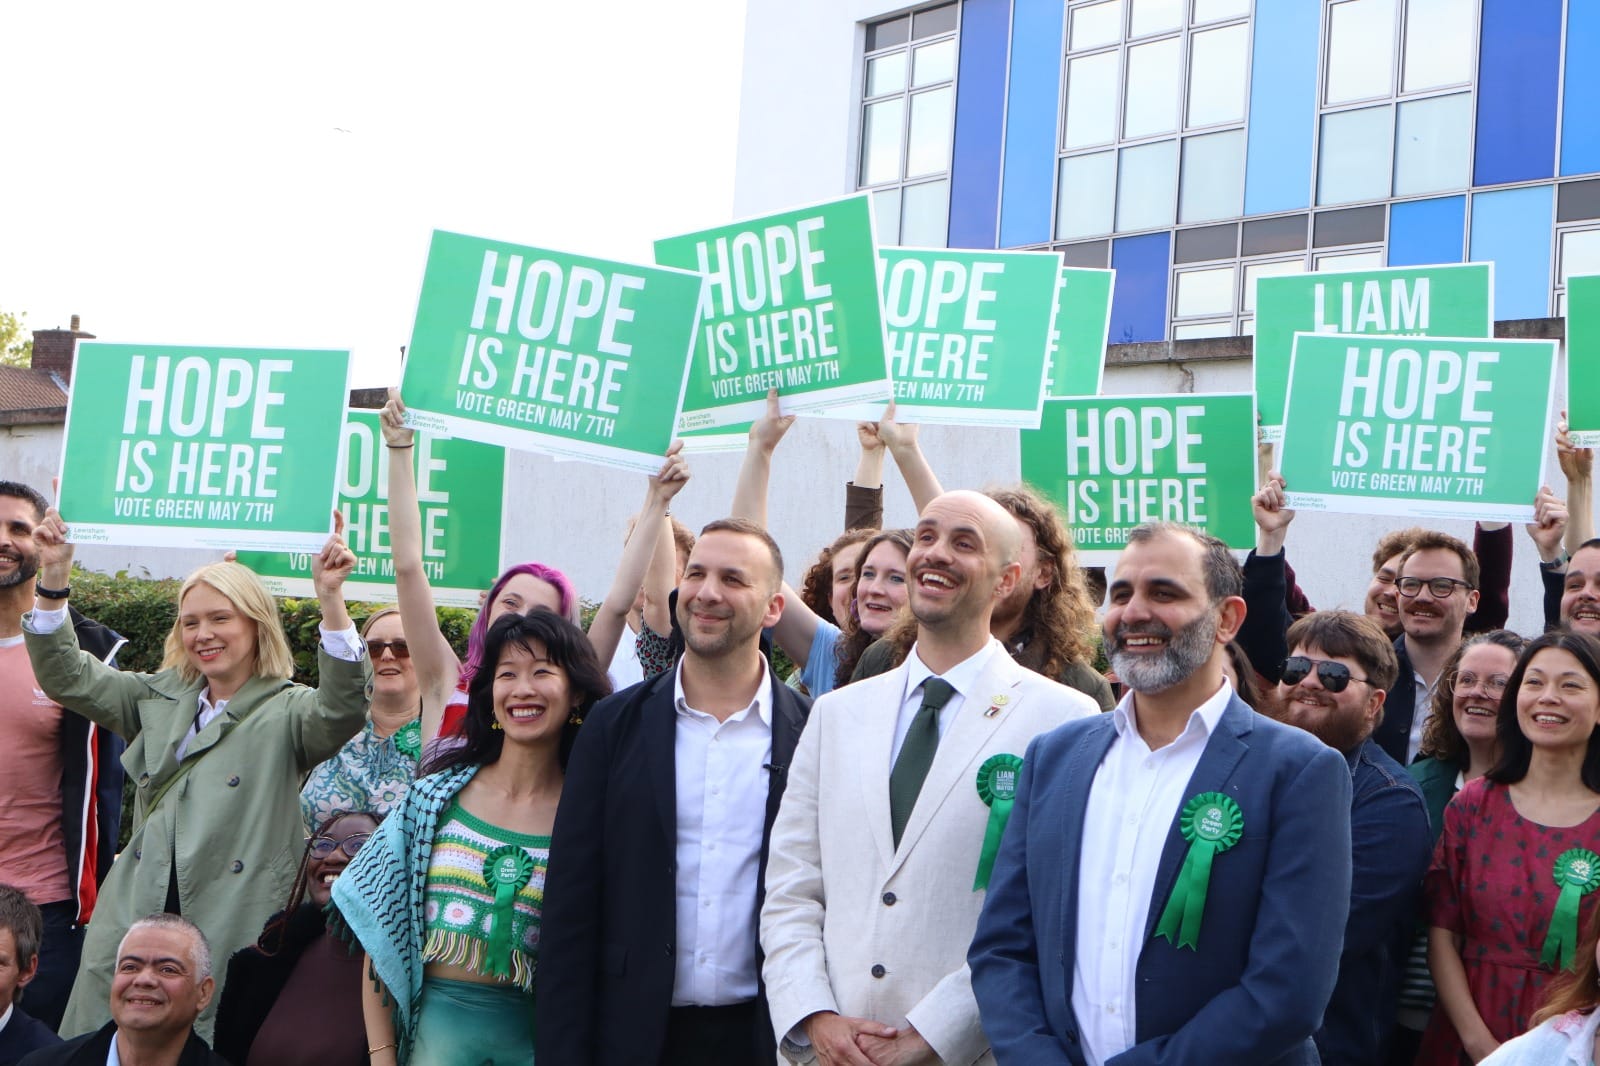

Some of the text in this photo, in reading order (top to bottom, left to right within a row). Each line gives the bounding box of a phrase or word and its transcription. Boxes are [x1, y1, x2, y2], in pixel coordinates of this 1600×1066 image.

[696, 216, 832, 319] HOPE
[470, 250, 646, 357] HOPE
[879, 258, 1005, 330] OPE
[1314, 277, 1430, 333] LIAM
[705, 302, 838, 376] IS HERE
[122, 355, 293, 439] HOPE
[458, 334, 629, 414] IS HERE
[712, 360, 840, 399] VOTE GREEN MAY 7TH
[921, 382, 953, 400] MAY
[956, 384, 984, 401] 7TH
[1339, 347, 1500, 422] HOPE
[456, 390, 616, 438] VOTE GREEN MAY 7TH
[1066, 406, 1207, 475] HOPE
[1332, 421, 1491, 473] IS HERE
[115, 439, 283, 497] IS HERE
[1332, 471, 1484, 495] VOTE GREEN MAY 7TH
[114, 497, 274, 523] VOTE GREEN MAY 7TH
[1067, 478, 1207, 524] IS HERE
[342, 502, 448, 557] HEE
[1071, 527, 1129, 544] VOTE GRE
[289, 553, 313, 570] VOT
[424, 561, 443, 579] TH
[996, 770, 1015, 779] LIAM
[1201, 817, 1223, 829] Green
[1201, 824, 1220, 835] Party
